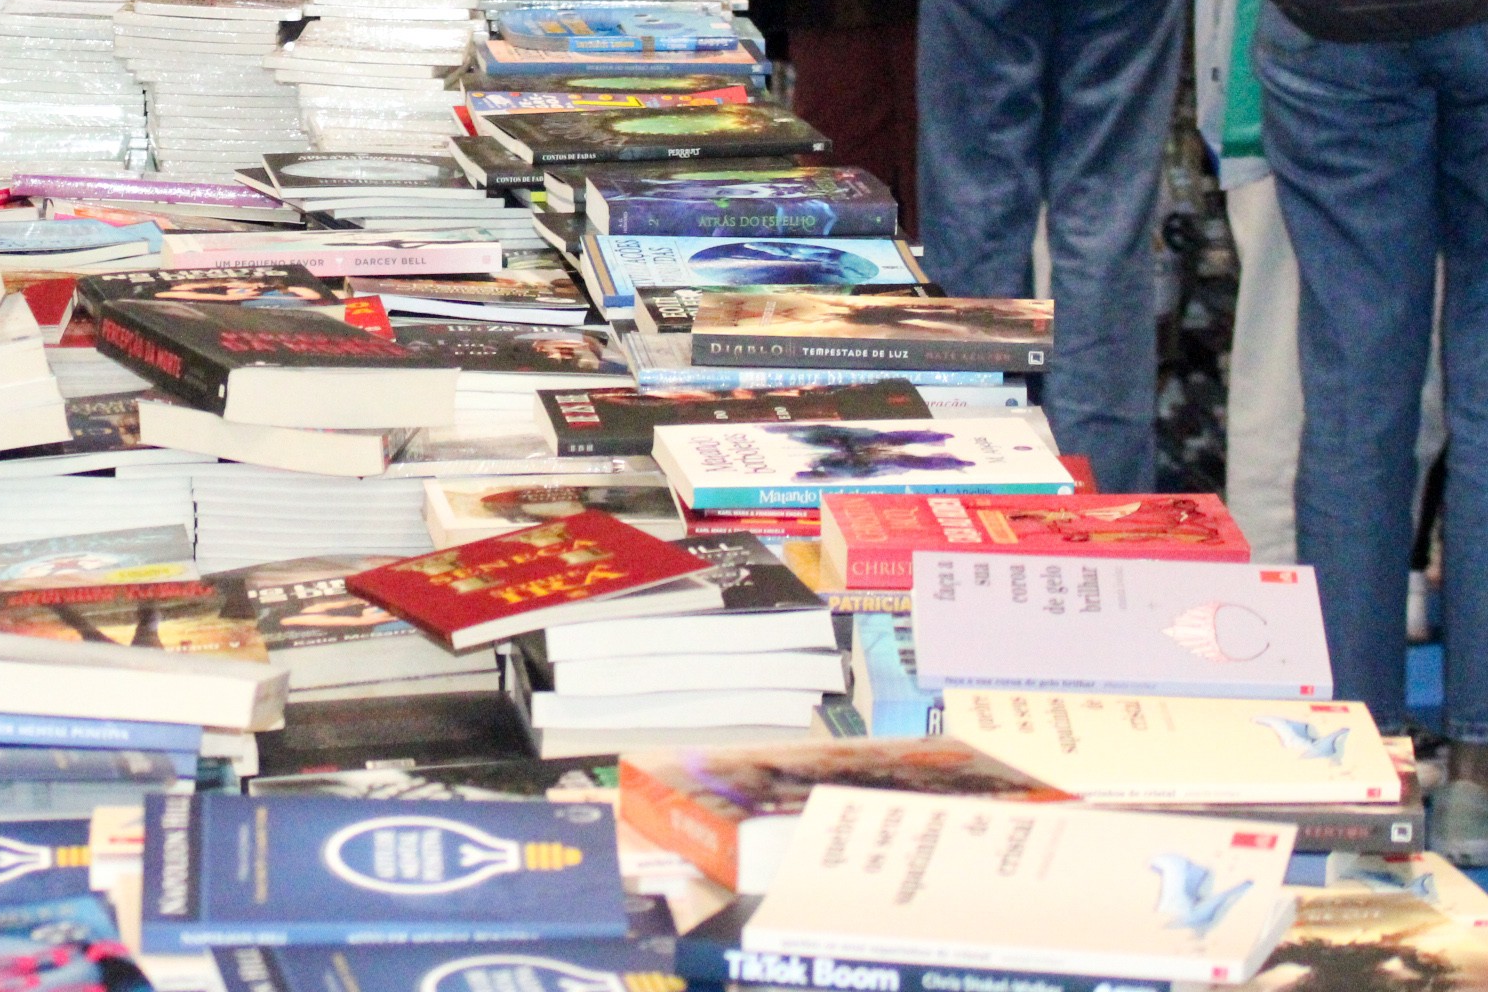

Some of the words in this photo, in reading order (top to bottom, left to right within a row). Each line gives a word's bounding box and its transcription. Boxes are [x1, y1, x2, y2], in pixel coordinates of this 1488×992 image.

[541, 153, 567, 162] CONTOS
[568, 153, 576, 161] DE
[576, 152, 598, 161] FADAS
[495, 175, 521, 184] CONTOS
[522, 175, 531, 183] DE
[532, 174, 546, 183] FAD
[698, 211, 737, 228] ATRÁS
[740, 214, 761, 228] DO
[215, 259, 232, 268] UM
[234, 258, 287, 268] PEQUENO
[289, 258, 325, 268] FAVOR
[354, 257, 399, 268] DARCEY
[401, 256, 427, 266] BELL
[709, 340, 784, 360] DIABLO
[801, 346, 870, 359] TEMPESTADE
[872, 348, 886, 359] DE
[887, 348, 910, 360] LUZ
[758, 488, 818, 506] Matando
[785, 510, 808, 518] ENGELS
[762, 527, 786, 535] ENGELS
[851, 560, 913, 577] CHRIST
[973, 561, 991, 587] sua
[932, 571, 957, 603] faça
[1010, 563, 1028, 605] coroa
[1046, 564, 1068, 596] gelo
[1078, 565, 1102, 614] brilhar
[828, 596, 912, 613] PATRICIA
[1042, 594, 1067, 616] de
[724, 948, 809, 986] TikTok
[813, 959, 900, 992] Boom
